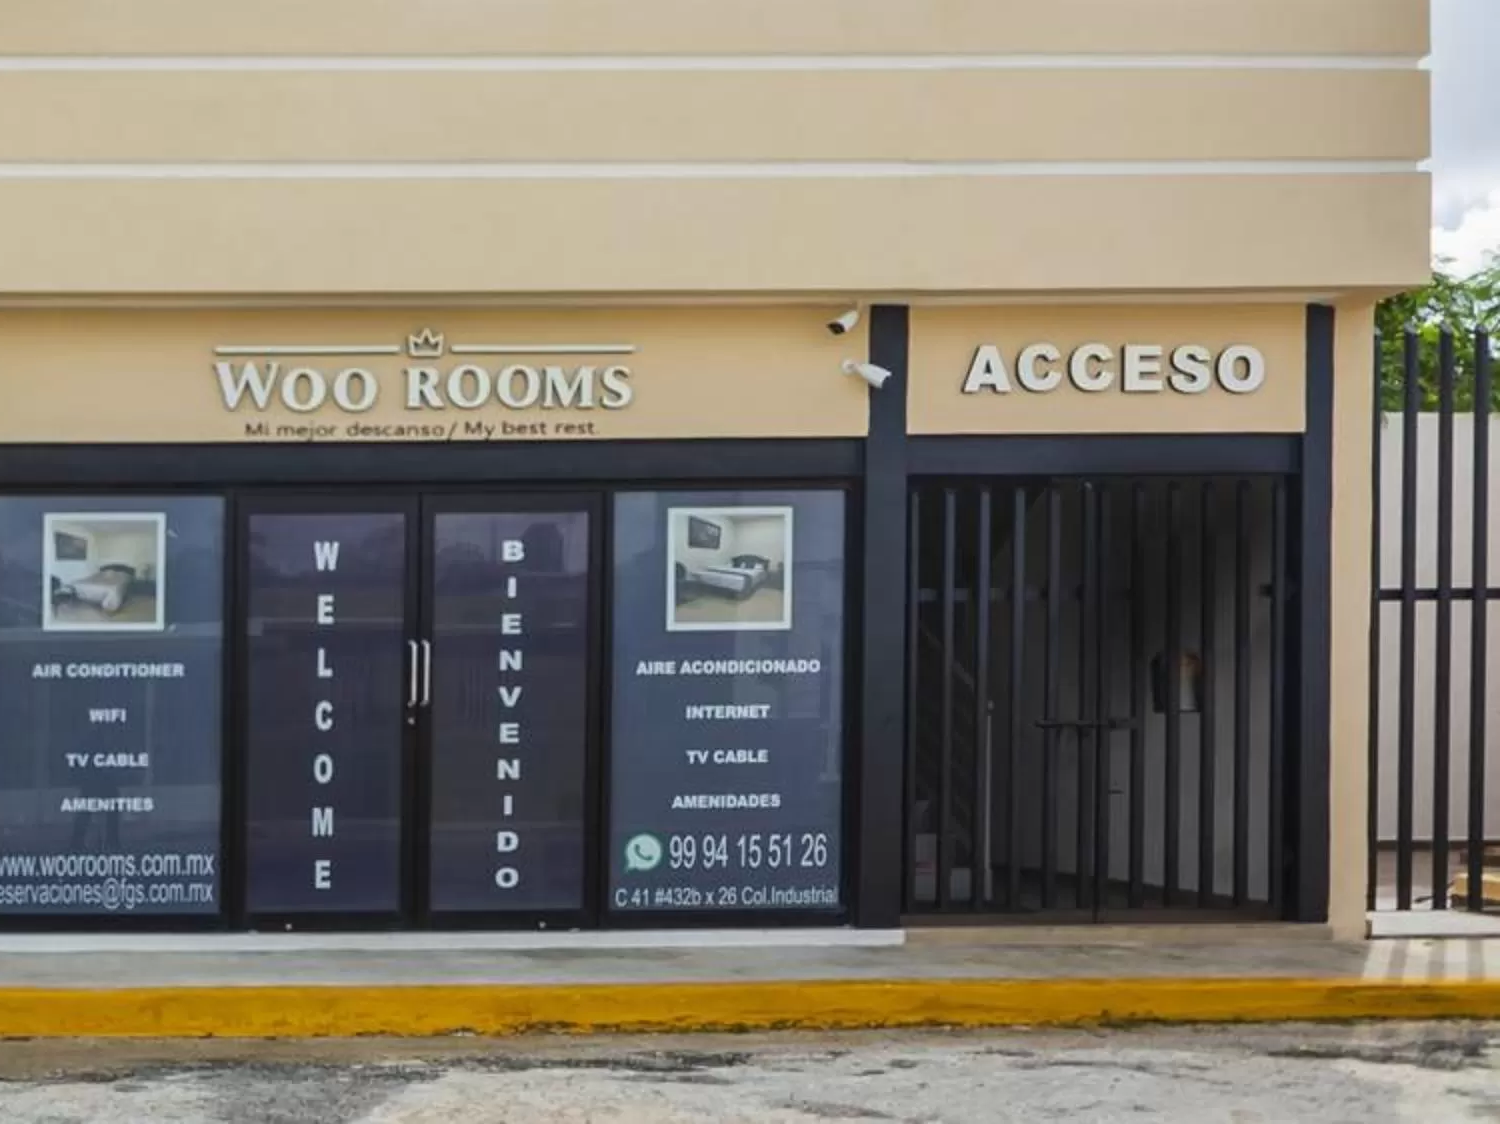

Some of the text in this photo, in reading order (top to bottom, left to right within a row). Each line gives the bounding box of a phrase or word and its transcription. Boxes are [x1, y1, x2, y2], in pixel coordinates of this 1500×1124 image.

[962, 343, 1266, 394] ACCESO
[405, 364, 634, 410] ROOMS
[245, 423, 270, 438] Mi
[276, 422, 337, 443] mejor
[464, 421, 495, 440] My
[502, 420, 548, 436] best
[32, 663, 185, 678] AIR CONDITIONER
[636, 659, 821, 675] AIRE ACONDICIONADO
[89, 708, 127, 723] WIFI
[311, 541, 340, 889] WELCOME
[495, 540, 525, 888] BIENVENIDO
[685, 704, 771, 719] INTERNET
[65, 752, 149, 768] TV CABLE
[686, 749, 769, 764] TV CABLE
[61, 798, 154, 812] AMENITIES
[672, 793, 781, 809] AMENIDADES
[669, 833, 827, 869] 99 94 15 51 26
[631, 889, 649, 907] 41
[706, 891, 714, 904] x
[718, 887, 737, 904] 26
